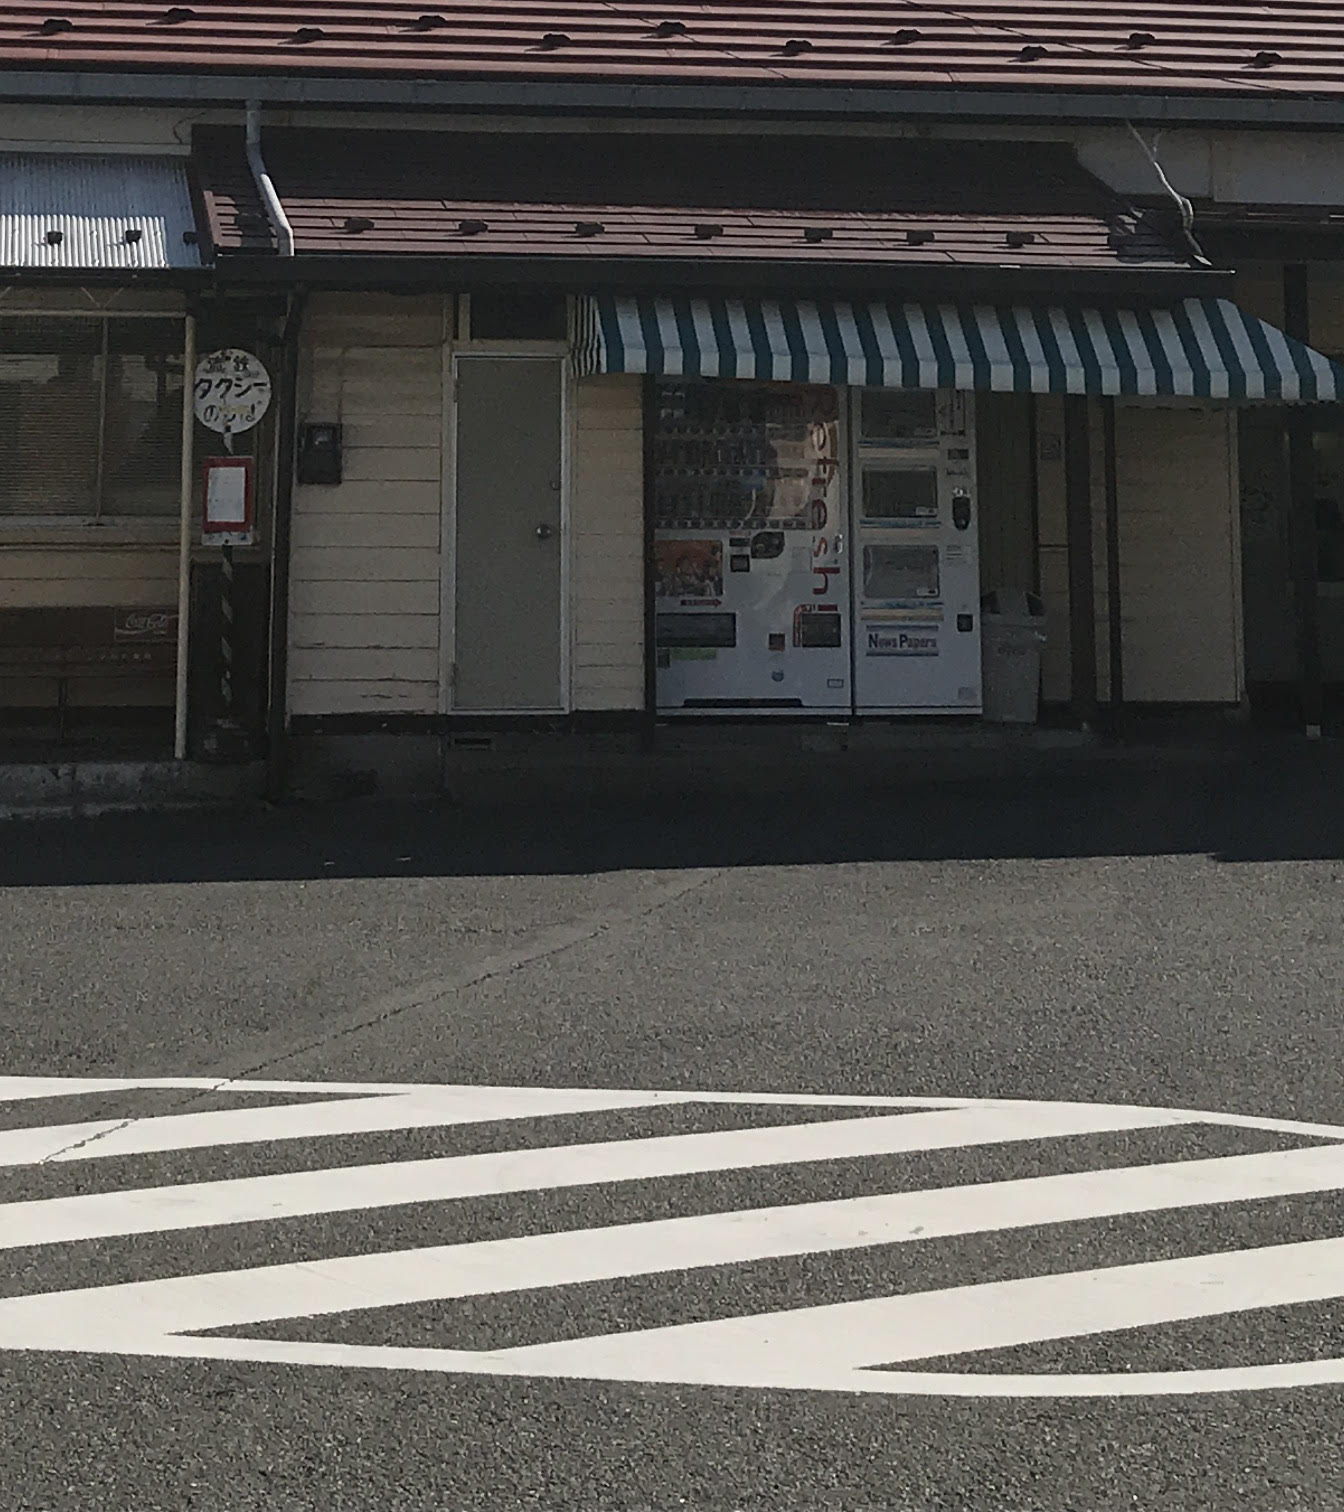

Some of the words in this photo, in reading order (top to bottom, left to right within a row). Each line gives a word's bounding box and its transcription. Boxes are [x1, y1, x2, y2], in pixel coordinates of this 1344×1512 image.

[194, 378, 268, 399] タクシー
[868, 633, 897, 649] News
[899, 633, 937, 651] Papers
